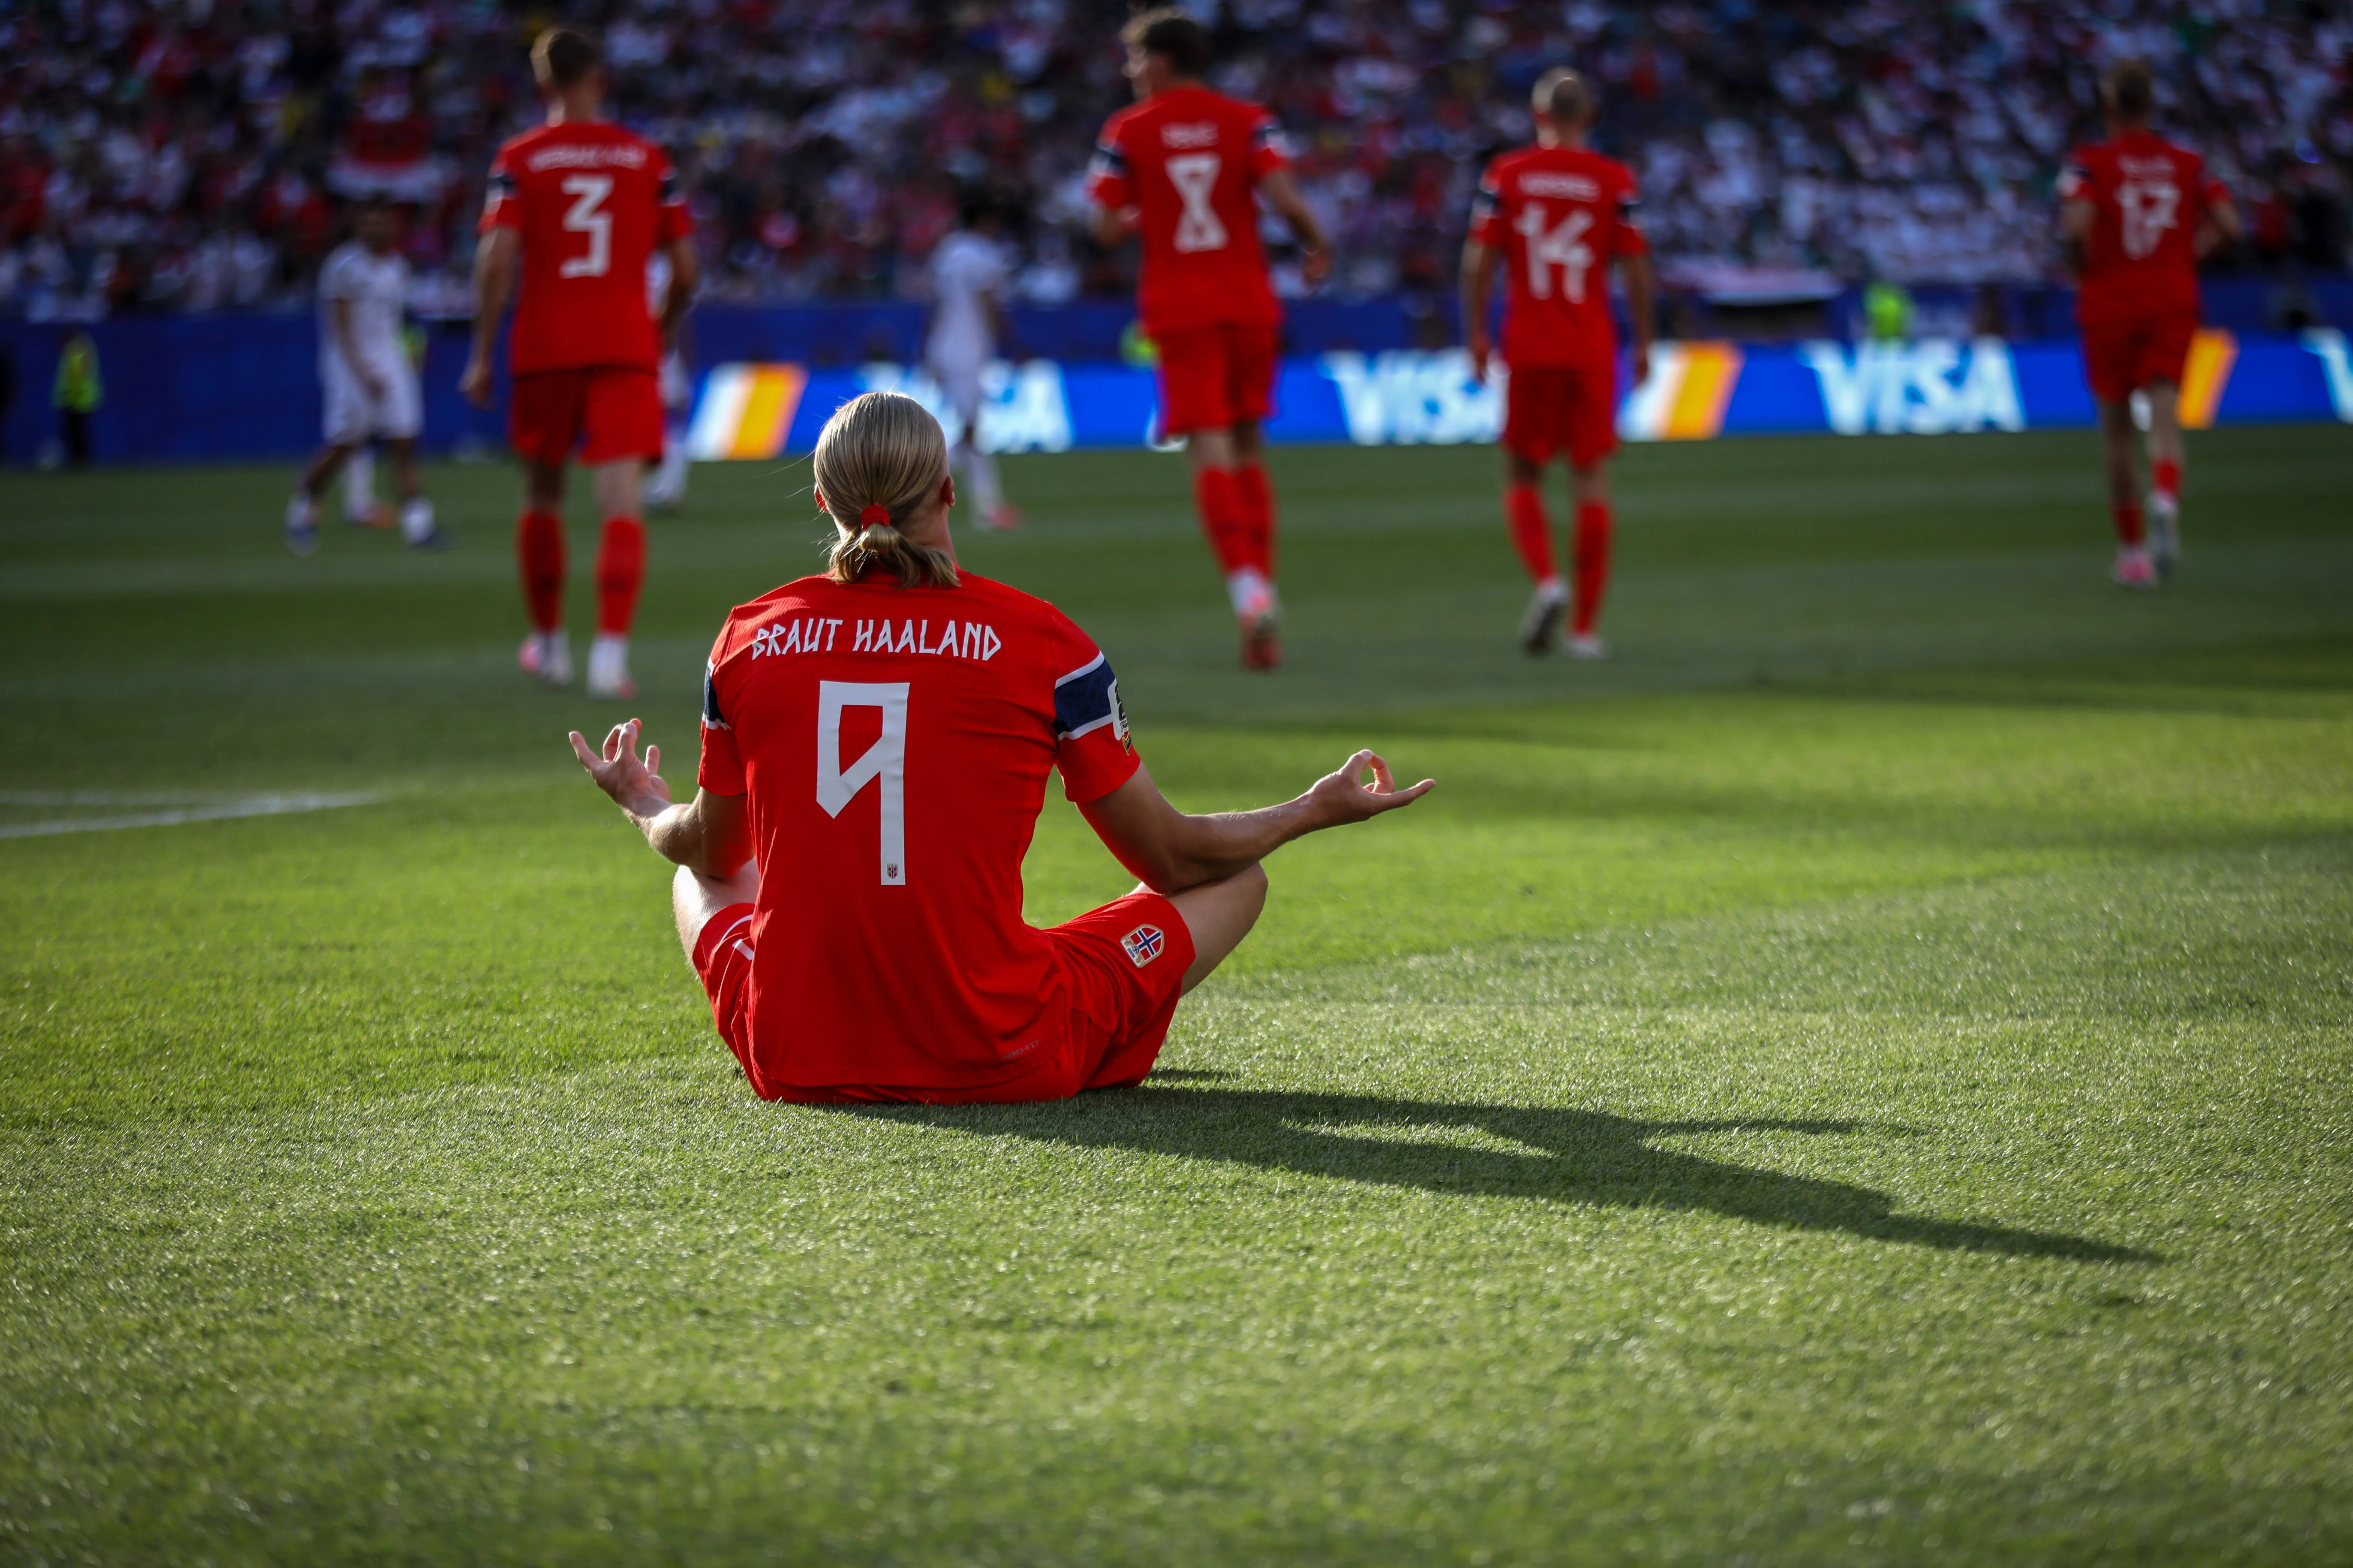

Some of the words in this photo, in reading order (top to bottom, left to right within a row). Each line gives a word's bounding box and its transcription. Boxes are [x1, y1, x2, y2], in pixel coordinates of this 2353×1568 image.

[561, 175, 613, 278] 3
[1166, 153, 1227, 252] 8
[1514, 203, 1593, 302] 14
[1801, 338, 2023, 433] VISA
[752, 619, 843, 660] BRAUT
[853, 620, 1001, 661] HAALAND
[817, 680, 910, 885] 9
